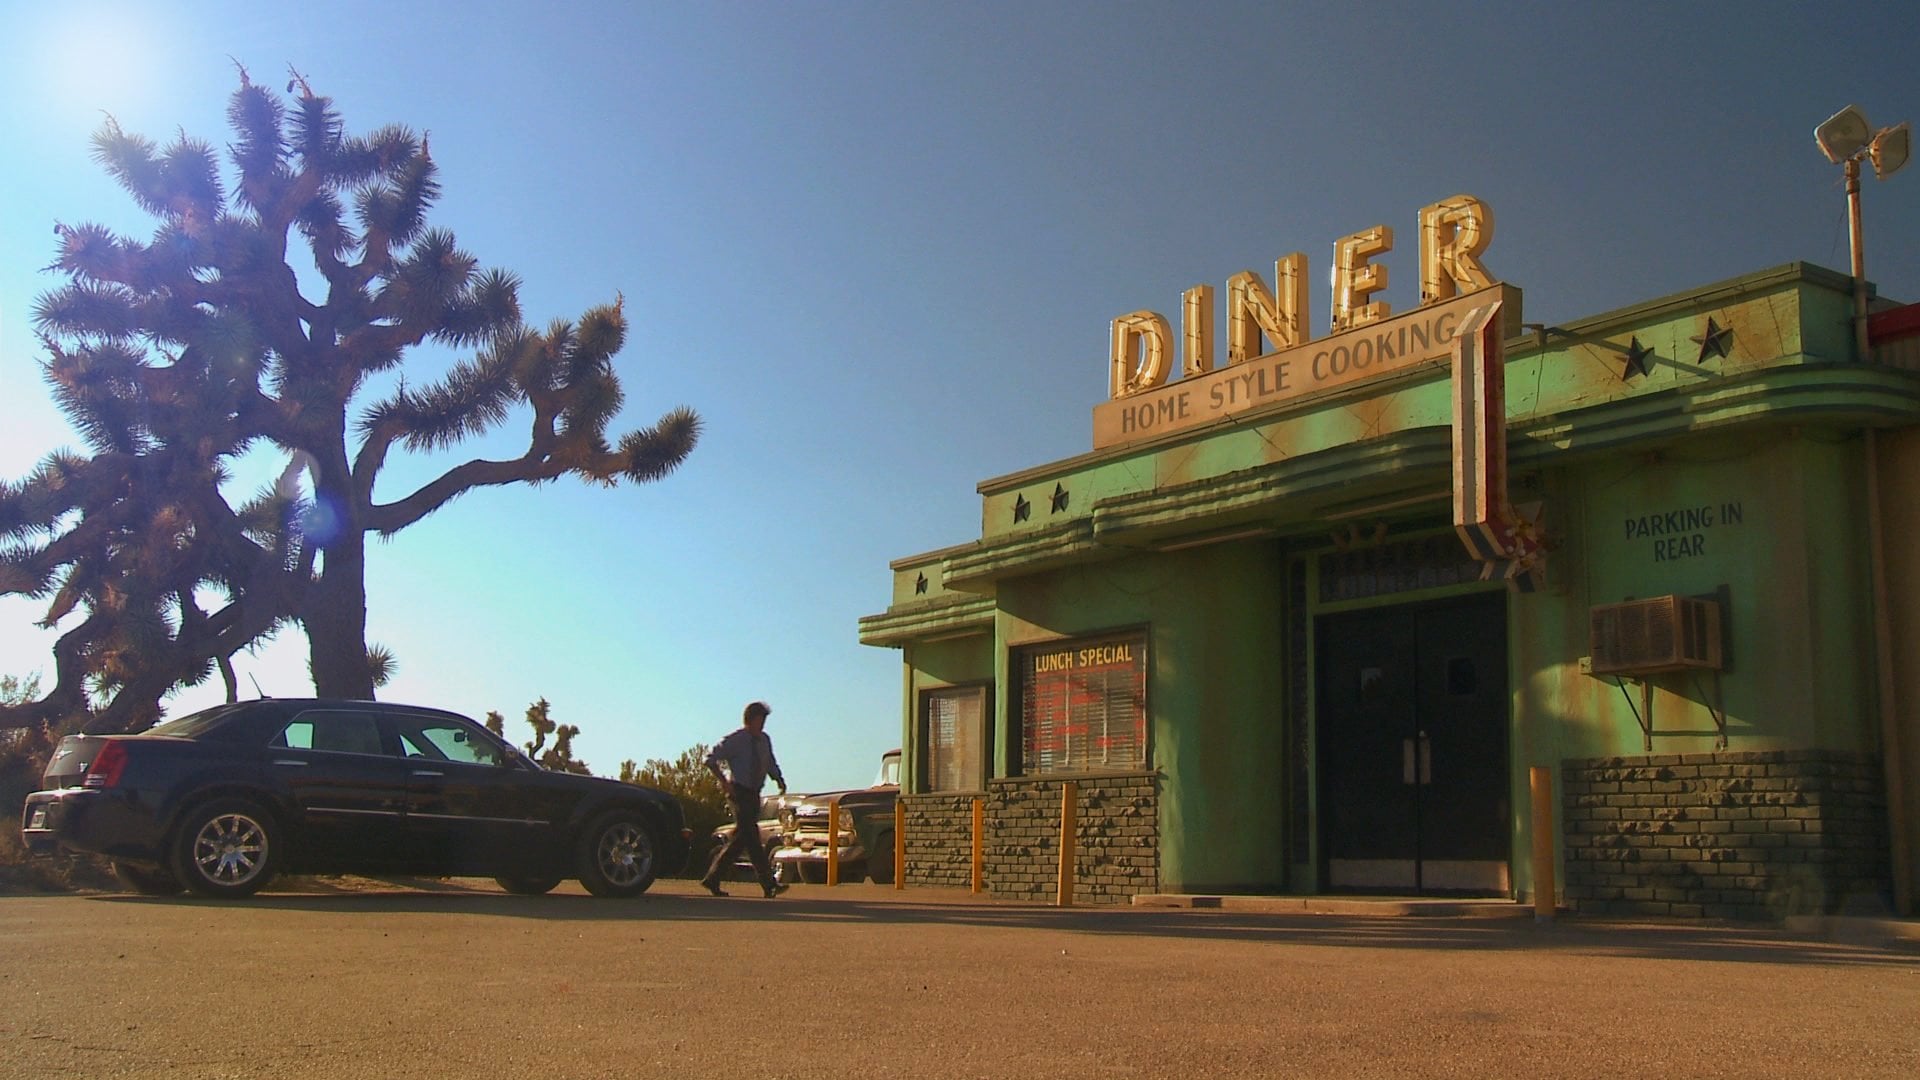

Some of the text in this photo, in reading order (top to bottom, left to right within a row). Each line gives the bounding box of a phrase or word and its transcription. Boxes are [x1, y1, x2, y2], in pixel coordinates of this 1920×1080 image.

[1108, 194, 1495, 399] DINER
[1122, 312, 1456, 434] HOME STYLE COOKING
[1625, 502, 1743, 540] PARKING IN
[1654, 533, 1705, 562] REAR
[1035, 644, 1133, 673] LUNCH SPECIAL
